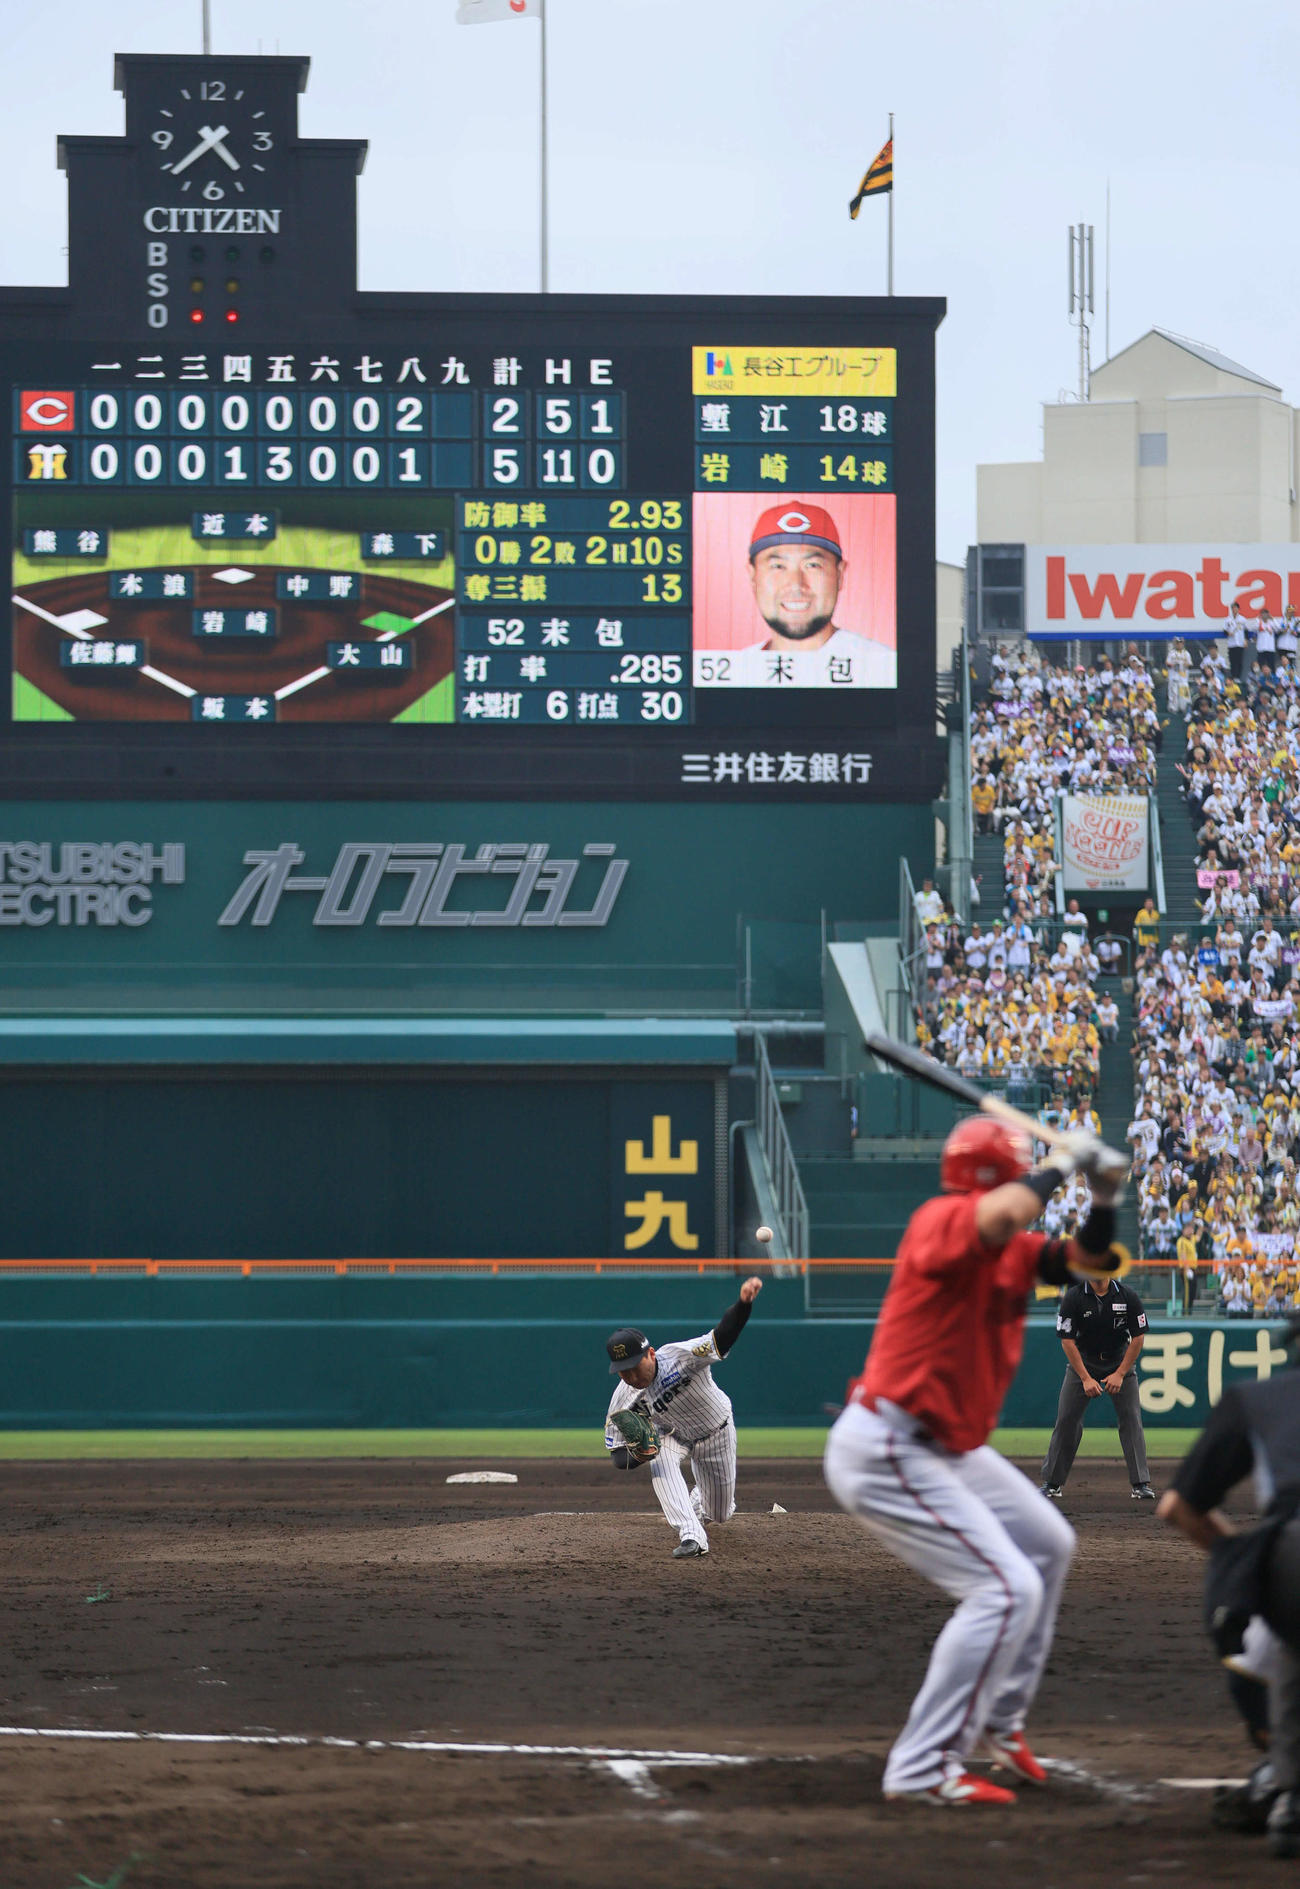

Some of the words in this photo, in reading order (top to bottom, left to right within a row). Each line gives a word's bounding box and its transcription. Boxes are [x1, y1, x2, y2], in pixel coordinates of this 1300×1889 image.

[200, 81, 227, 101] 12
[151, 130, 174, 150] 9
[252, 131, 274, 151] 3
[202, 181, 225, 201] 6
[143, 206, 282, 234] CITIZEN
[147, 242, 168, 267] B
[147, 273, 169, 298] S
[135, 354, 166, 379] 二
[179, 354, 209, 380] 三
[223, 354, 252, 382] 四
[265, 354, 297, 382] 五
[310, 355, 340, 382] 六
[353, 355, 383, 383] 七
[396, 356, 427, 383] 八
[441, 356, 470, 384] 九
[493, 356, 523, 386] 計
[545, 358, 572, 385] H
[590, 358, 613, 385] E
[90, 394, 118, 431] 0
[134, 394, 162, 431] 0
[178, 395, 206, 431] 0
[221, 396, 249, 431] 0
[265, 396, 293, 431] 0
[309, 396, 336, 432] 0
[352, 396, 380, 432] 0
[395, 397, 424, 432] 2
[492, 398, 519, 433] 2
[545, 399, 572, 434] 5
[591, 400, 613, 433] 1
[90, 444, 118, 481] 0
[134, 444, 162, 481] 0
[178, 445, 206, 481] 0
[224, 446, 247, 480] 1
[265, 446, 293, 481] 3
[309, 446, 336, 482] 0
[352, 446, 380, 482] 0
[398, 447, 421, 482] 1
[493, 448, 519, 484] 5
[543, 449, 575, 483] 11
[588, 448, 615, 484] 0
[608, 500, 683, 530] 2.93
[642, 573, 683, 603] 13
[488, 618, 525, 646] 52
[610, 654, 683, 684] .285
[700, 658, 731, 681] 52
[546, 690, 569, 720] 6
[578, 692, 619, 719] 打点
[640, 691, 683, 721] 30
[681, 752, 873, 783] 三井住友銀行
[624, 1115, 699, 1251] 山九
